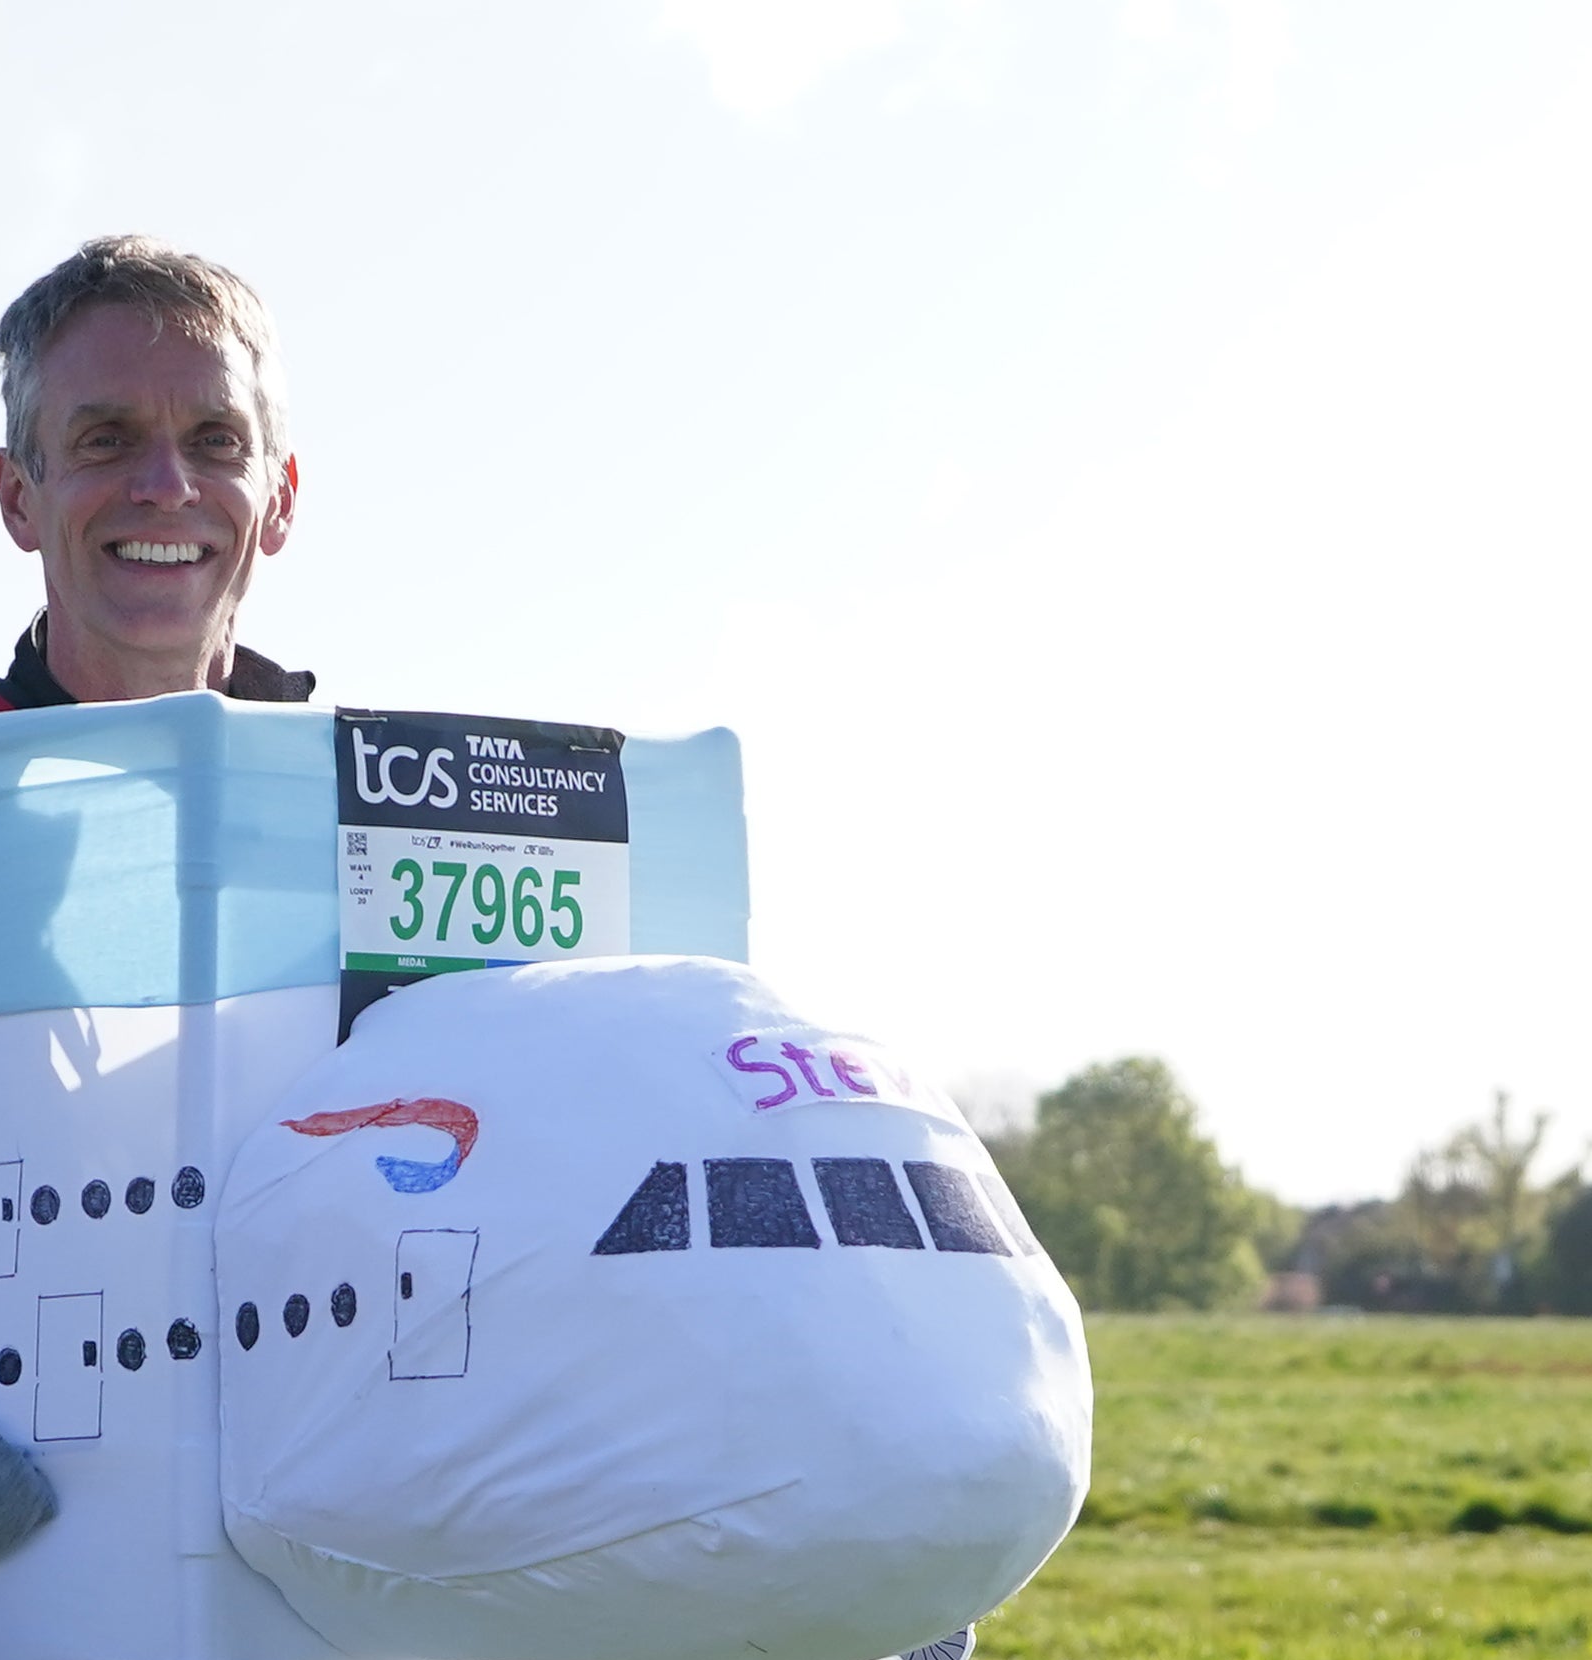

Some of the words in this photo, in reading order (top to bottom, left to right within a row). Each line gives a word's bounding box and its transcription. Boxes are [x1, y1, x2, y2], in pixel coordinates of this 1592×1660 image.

[465, 735, 525, 760] TATA
[352, 727, 458, 808] tcs
[468, 762, 606, 793] CONSULTANCY
[470, 790, 558, 816] SERVICES
[349, 863, 372, 872] WAVE
[349, 887, 374, 896] LORRY
[389, 858, 583, 949] 37965
[397, 957, 427, 969] MEDAL
